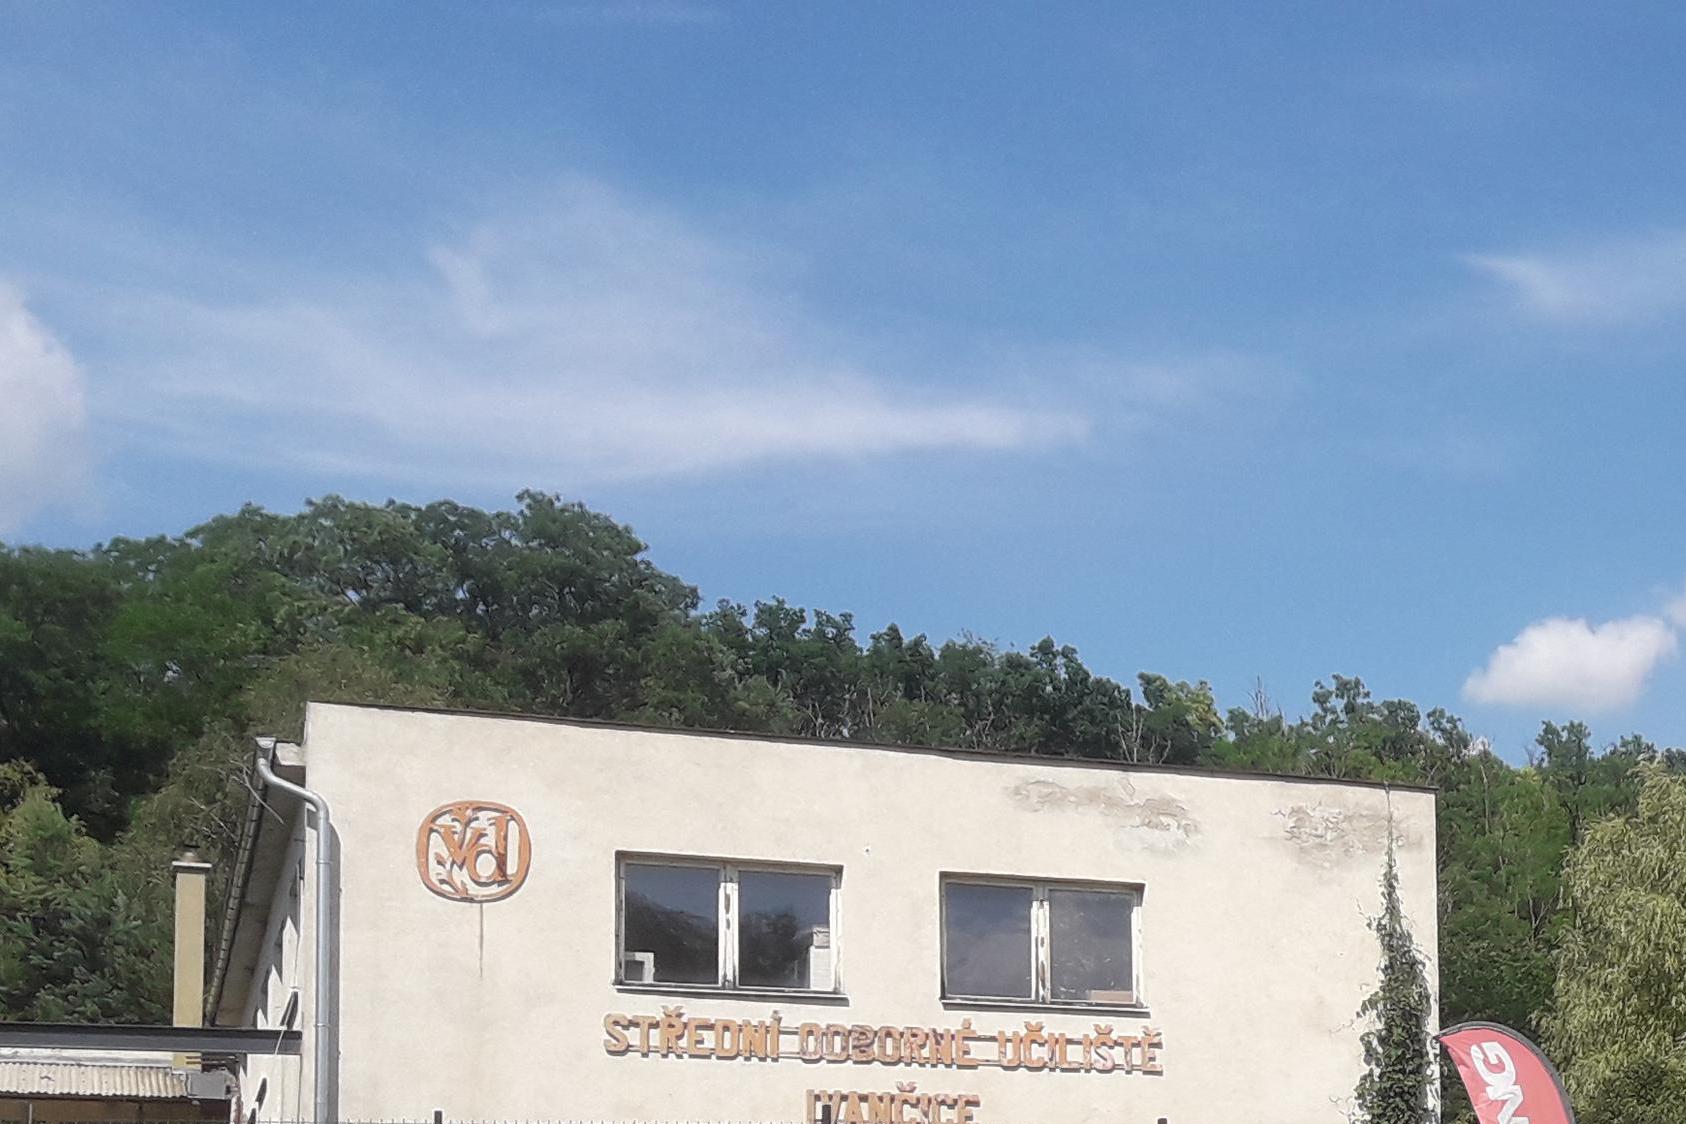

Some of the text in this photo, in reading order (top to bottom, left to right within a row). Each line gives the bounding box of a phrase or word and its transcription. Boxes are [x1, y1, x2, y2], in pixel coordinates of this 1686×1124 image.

[603, 1005, 1164, 1075] STŘEDNÍ ODBORNÉ UČILIŠTĚ
